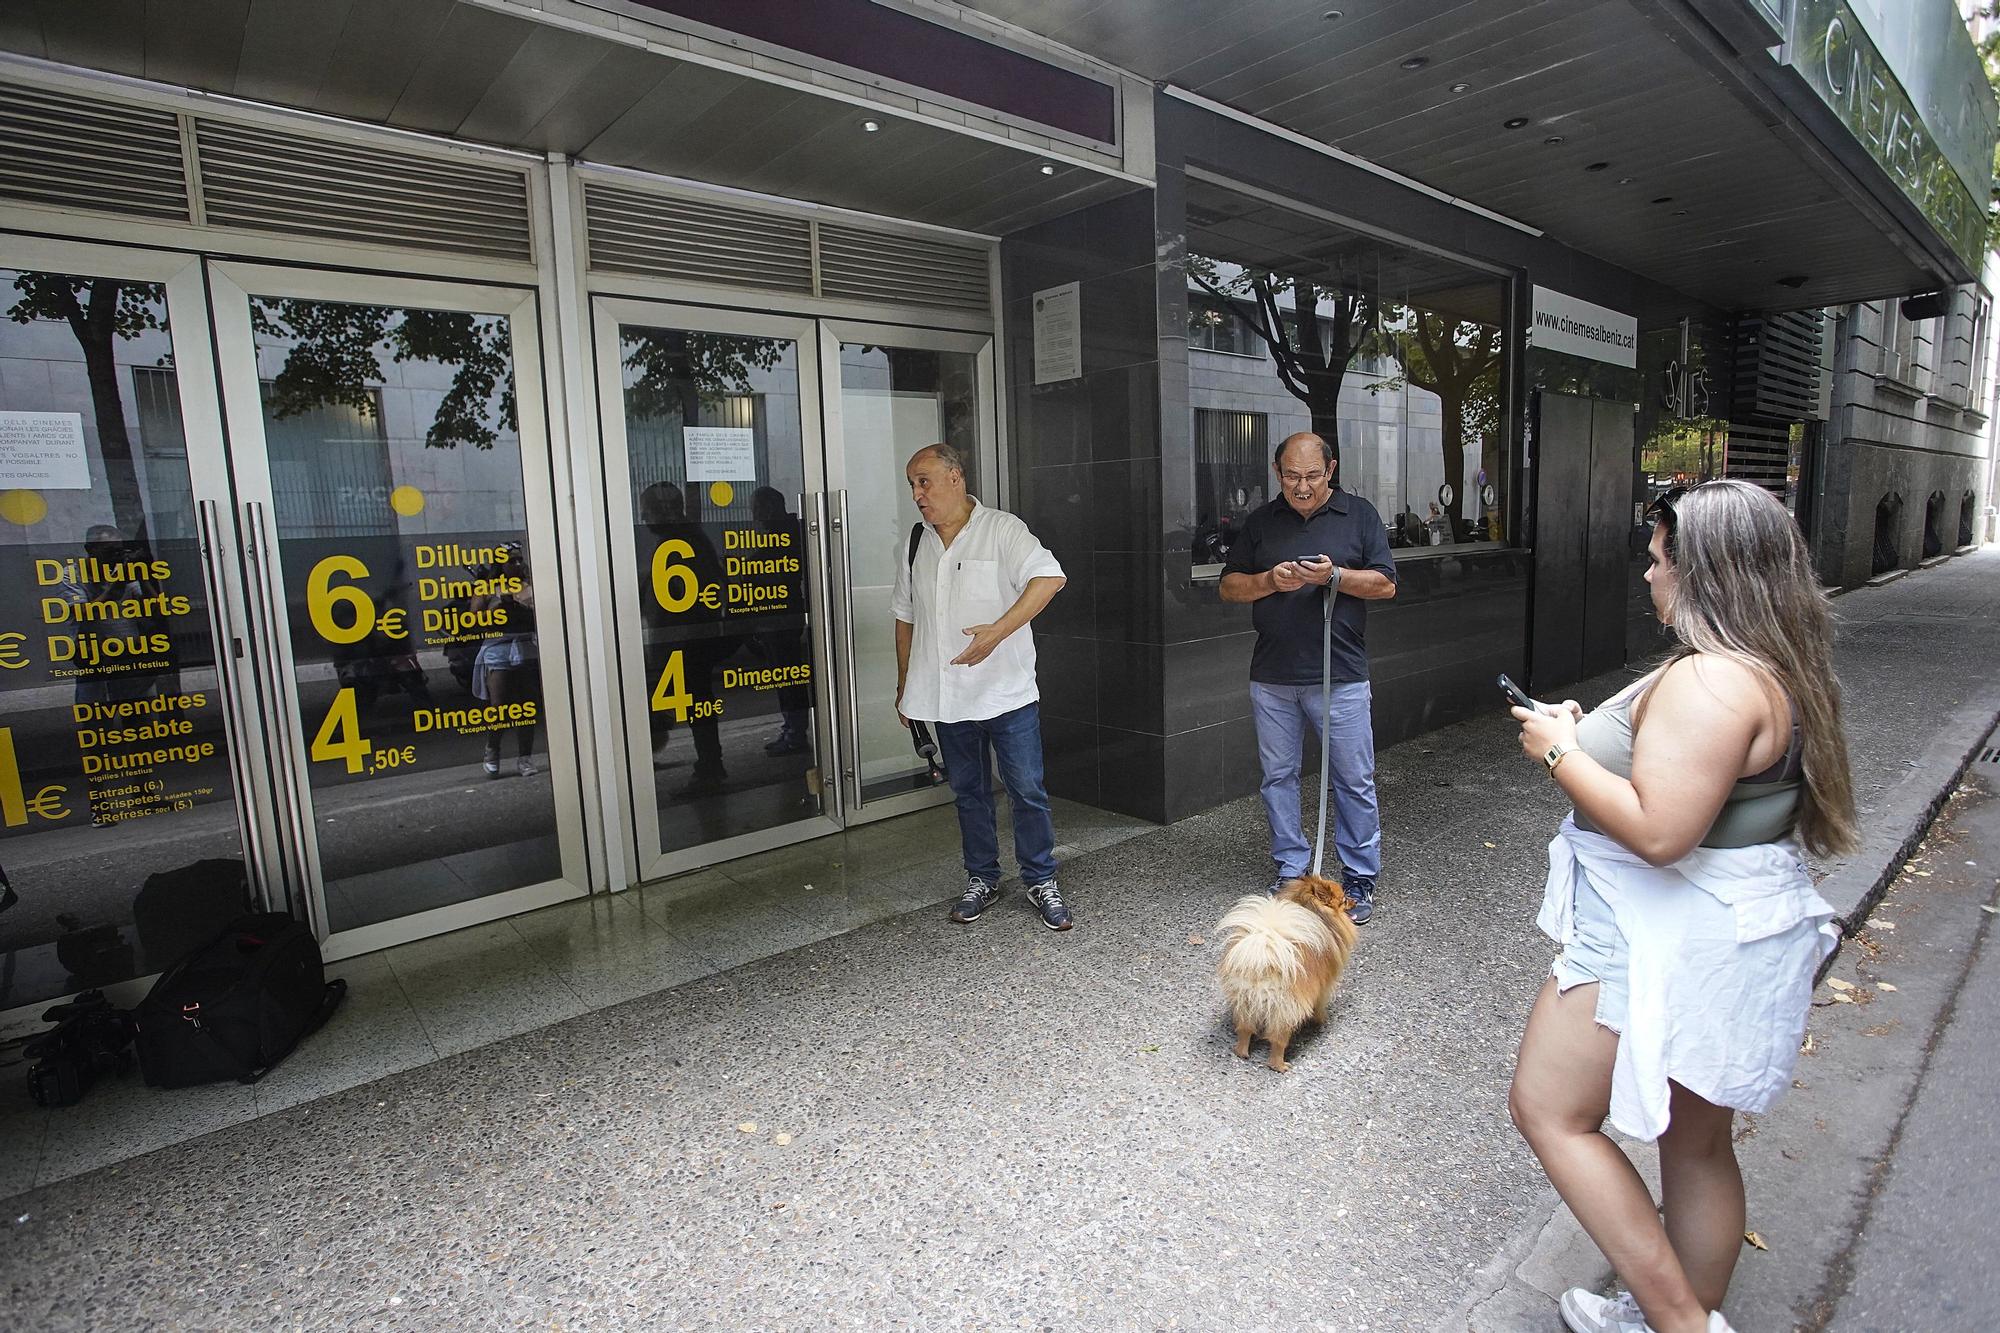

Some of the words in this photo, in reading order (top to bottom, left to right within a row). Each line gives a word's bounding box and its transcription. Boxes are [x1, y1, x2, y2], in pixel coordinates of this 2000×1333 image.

[1536, 310, 1634, 349] www.cinemesalbeniz.cat
[725, 530, 791, 549] Dilluns
[416, 544, 509, 568] Dilluns
[726, 555, 799, 576] Dimarts
[35, 557, 171, 586] Dilluns
[419, 574, 522, 601] Dimarts
[728, 583, 788, 606] Dijous
[41, 592, 191, 624] Dimarts
[423, 608, 508, 635] Dijous
[48, 633, 170, 665] Dijous
[97, 664, 131, 674] vigilies
[138, 660, 170, 670] festius
[723, 664, 811, 689] Dimecres
[73, 693, 207, 723] Divendres
[414, 701, 536, 732] Dimecres
[77, 718, 193, 749] Dissabte
[82, 742, 214, 774] Diumenge
[89, 785, 140, 800] Entrada
[91, 793, 161, 812] +Crispetes
[94, 808, 152, 824] +Refresc
